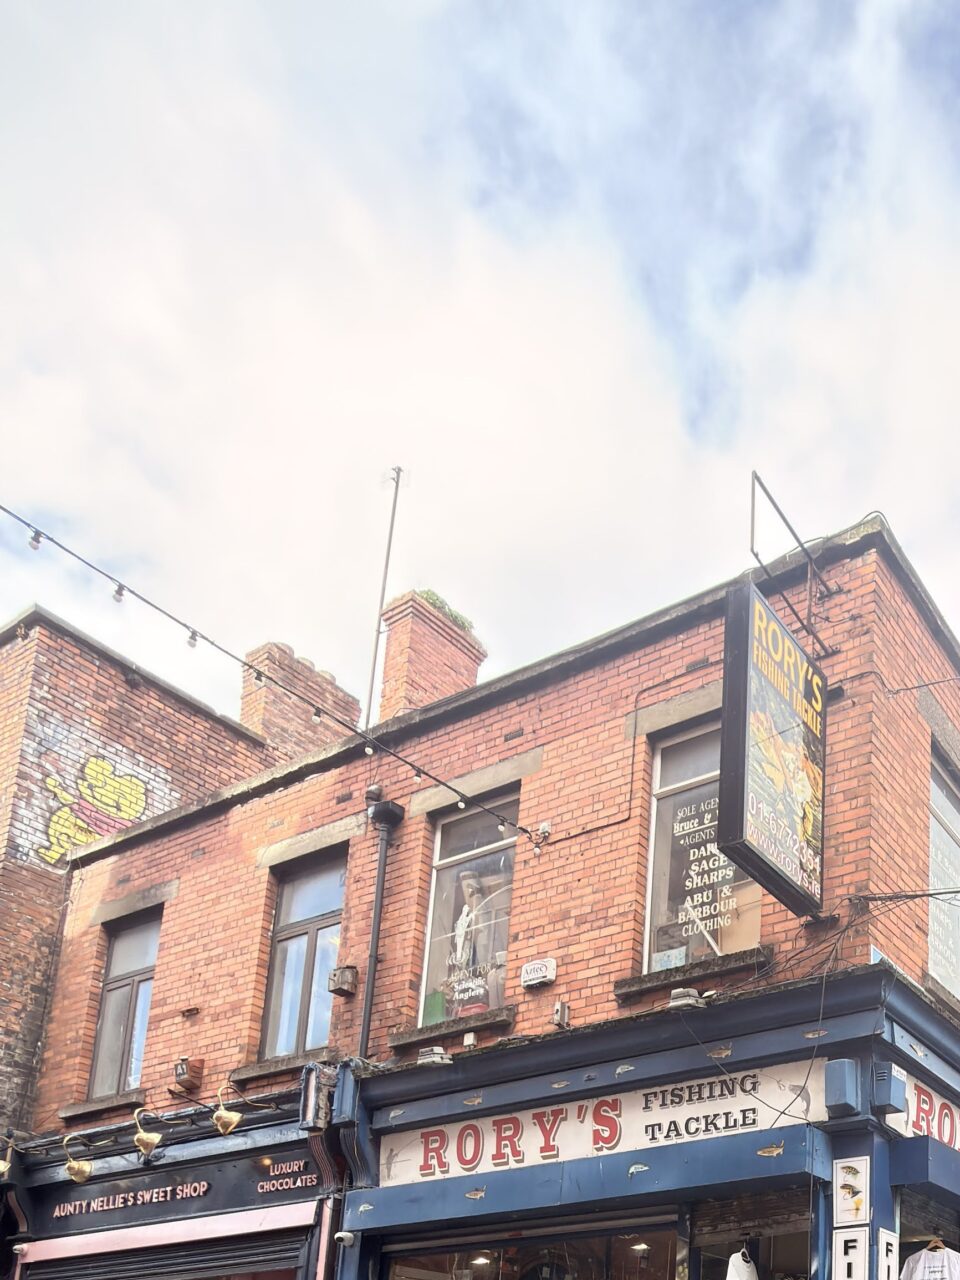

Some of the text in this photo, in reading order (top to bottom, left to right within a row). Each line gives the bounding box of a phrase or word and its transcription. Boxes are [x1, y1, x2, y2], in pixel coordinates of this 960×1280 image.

[754, 601, 822, 713] RORY'S
[753, 639, 821, 738] FISHING TACKLE
[677, 798, 719, 819] SOLE AGEN
[673, 818, 699, 834] Bruce
[684, 828, 715, 846] AGENTS
[690, 855, 728, 873] SAGE
[747, 822, 821, 898] www.rorys.ie
[684, 885, 733, 907] ABU &
[678, 898, 737, 924] BARBOUR
[682, 914, 731, 937] CLOTHING
[642, 1073, 759, 1111] FISHING
[644, 1107, 758, 1142] TACKLE
[420, 1098, 622, 1177] RORY'S
[269, 1160, 305, 1176] LUXURY
[257, 1174, 318, 1193] CHOCOLATES
[53, 1181, 208, 1219] AUNTY NELLIE'S SWEET SHOP
